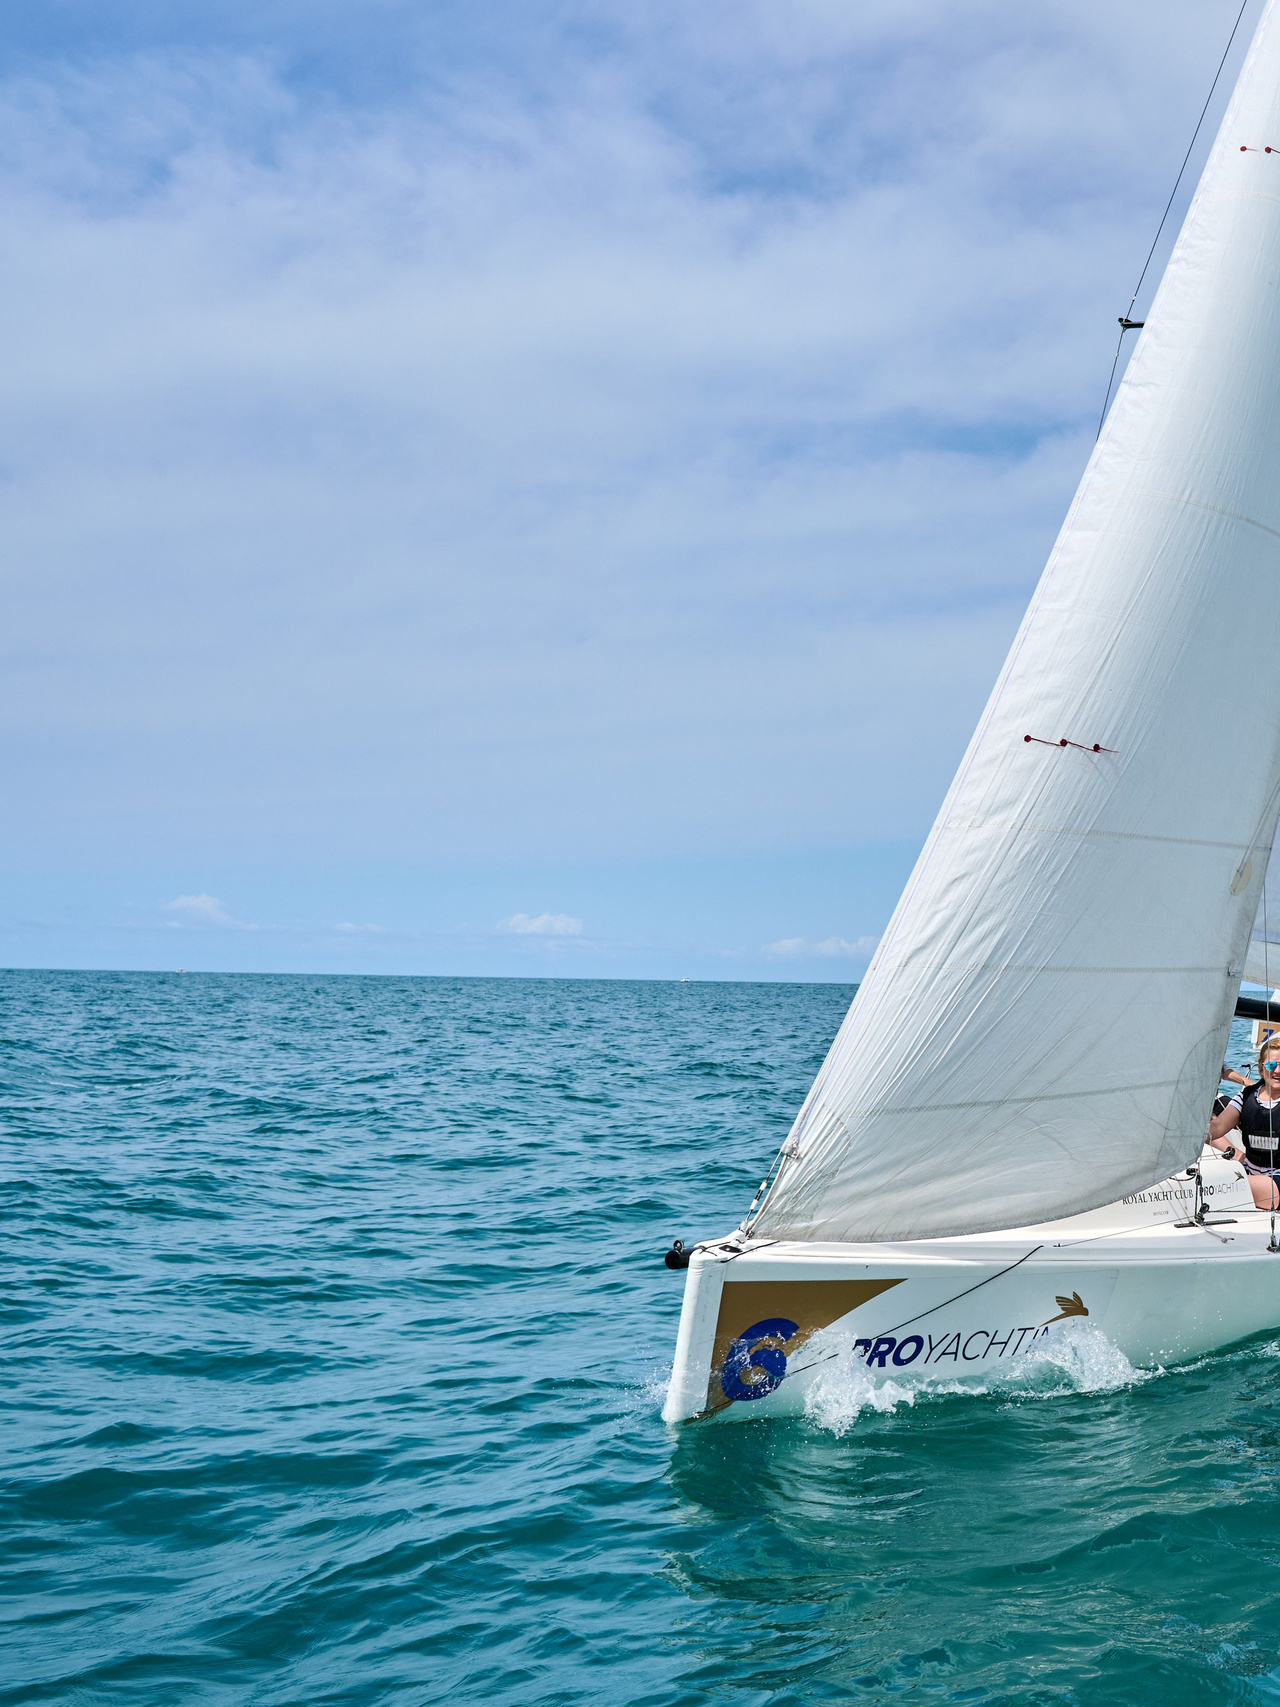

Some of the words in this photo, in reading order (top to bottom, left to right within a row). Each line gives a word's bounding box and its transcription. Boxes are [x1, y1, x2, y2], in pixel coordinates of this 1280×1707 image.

[1261, 1028, 1275, 1043] 7
[1122, 1192, 1148, 1206] ROYAL
[1148, 1190, 1173, 1203] YACHT
[1174, 1188, 1194, 1200] CLUB
[721, 1317, 800, 1402] 6
